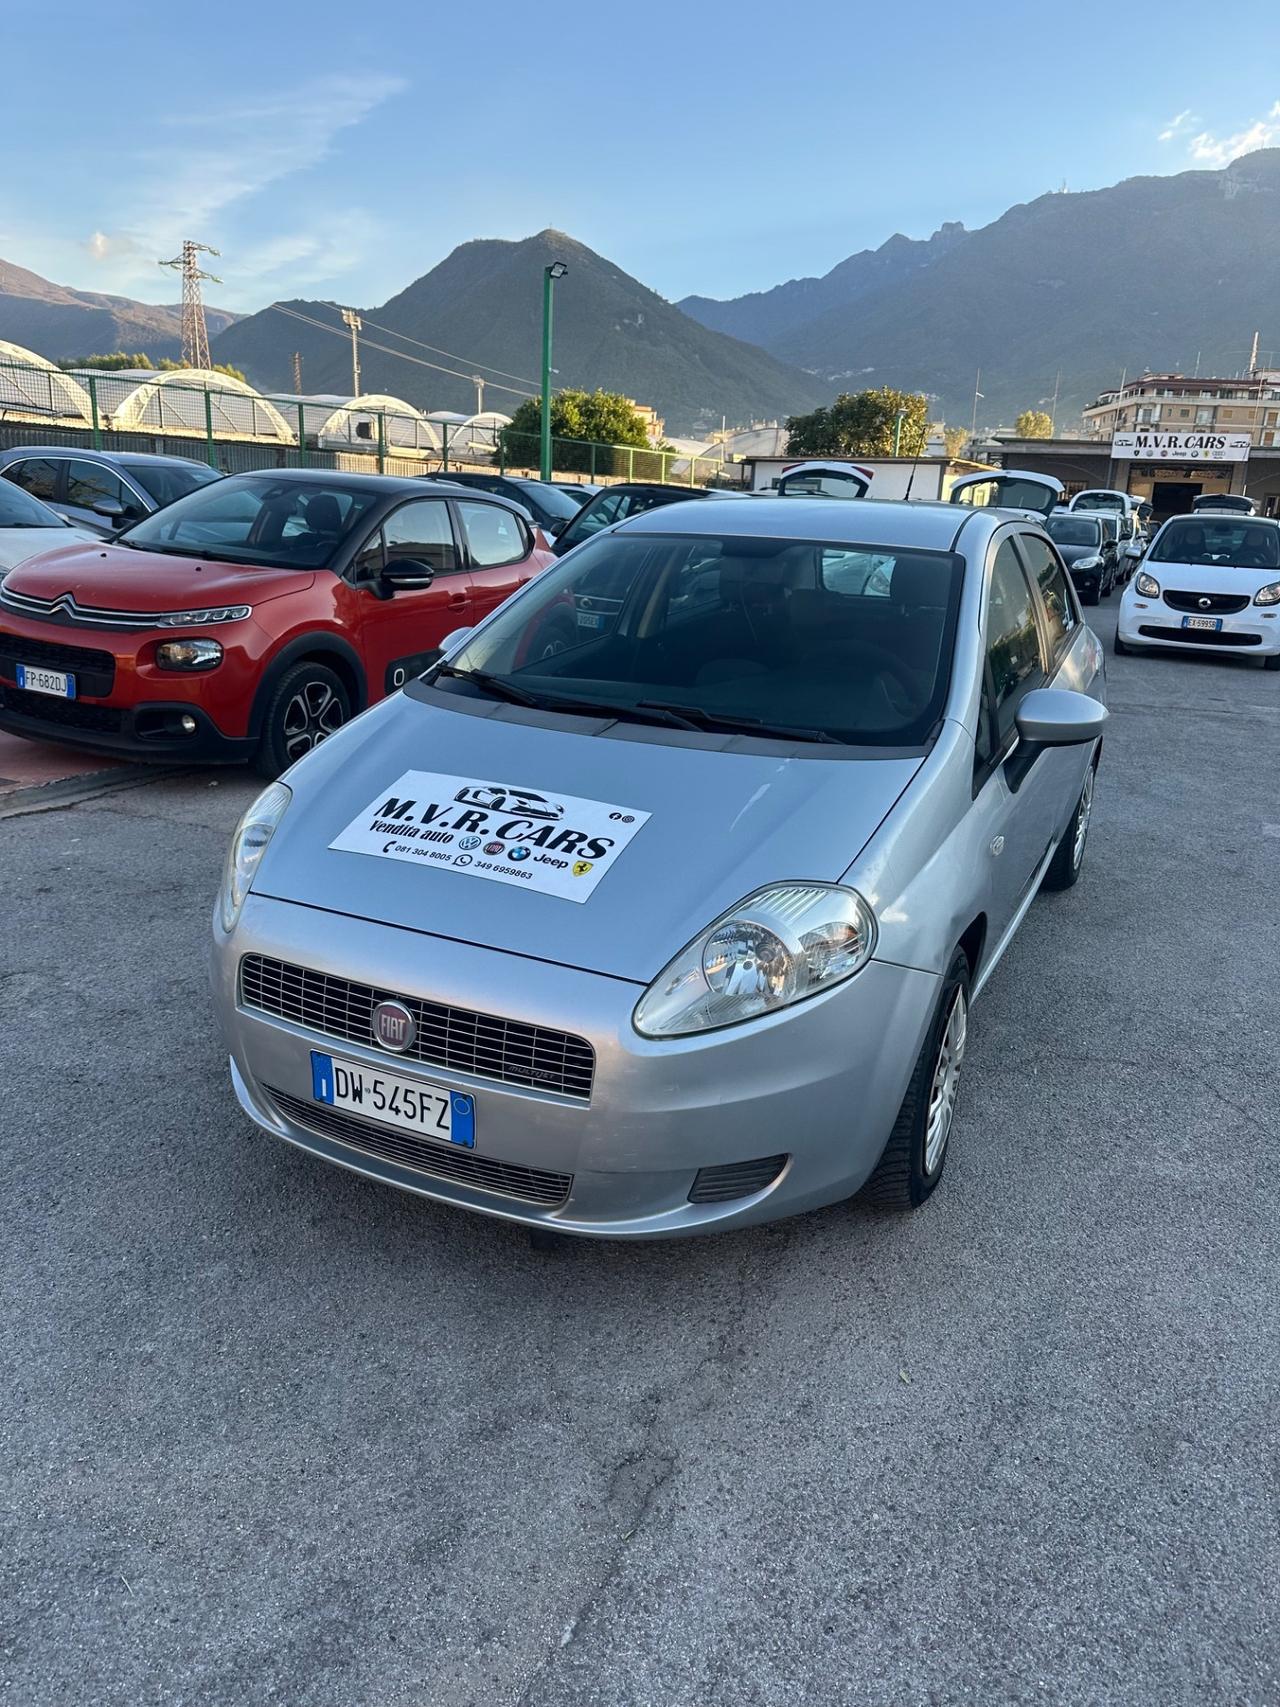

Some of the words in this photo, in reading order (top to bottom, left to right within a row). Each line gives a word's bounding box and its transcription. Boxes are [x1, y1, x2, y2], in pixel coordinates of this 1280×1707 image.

[369, 820, 421, 838] Vendita
[422, 828, 454, 845] auto
[394, 845, 411, 853] 081
[412, 847, 429, 857] 304
[429, 849, 453, 862] 8005
[533, 853, 569, 870] Jeep
[474, 860, 492, 870] 349
[492, 865, 533, 880] 6959863
[381, 1014, 406, 1041] FIAT
